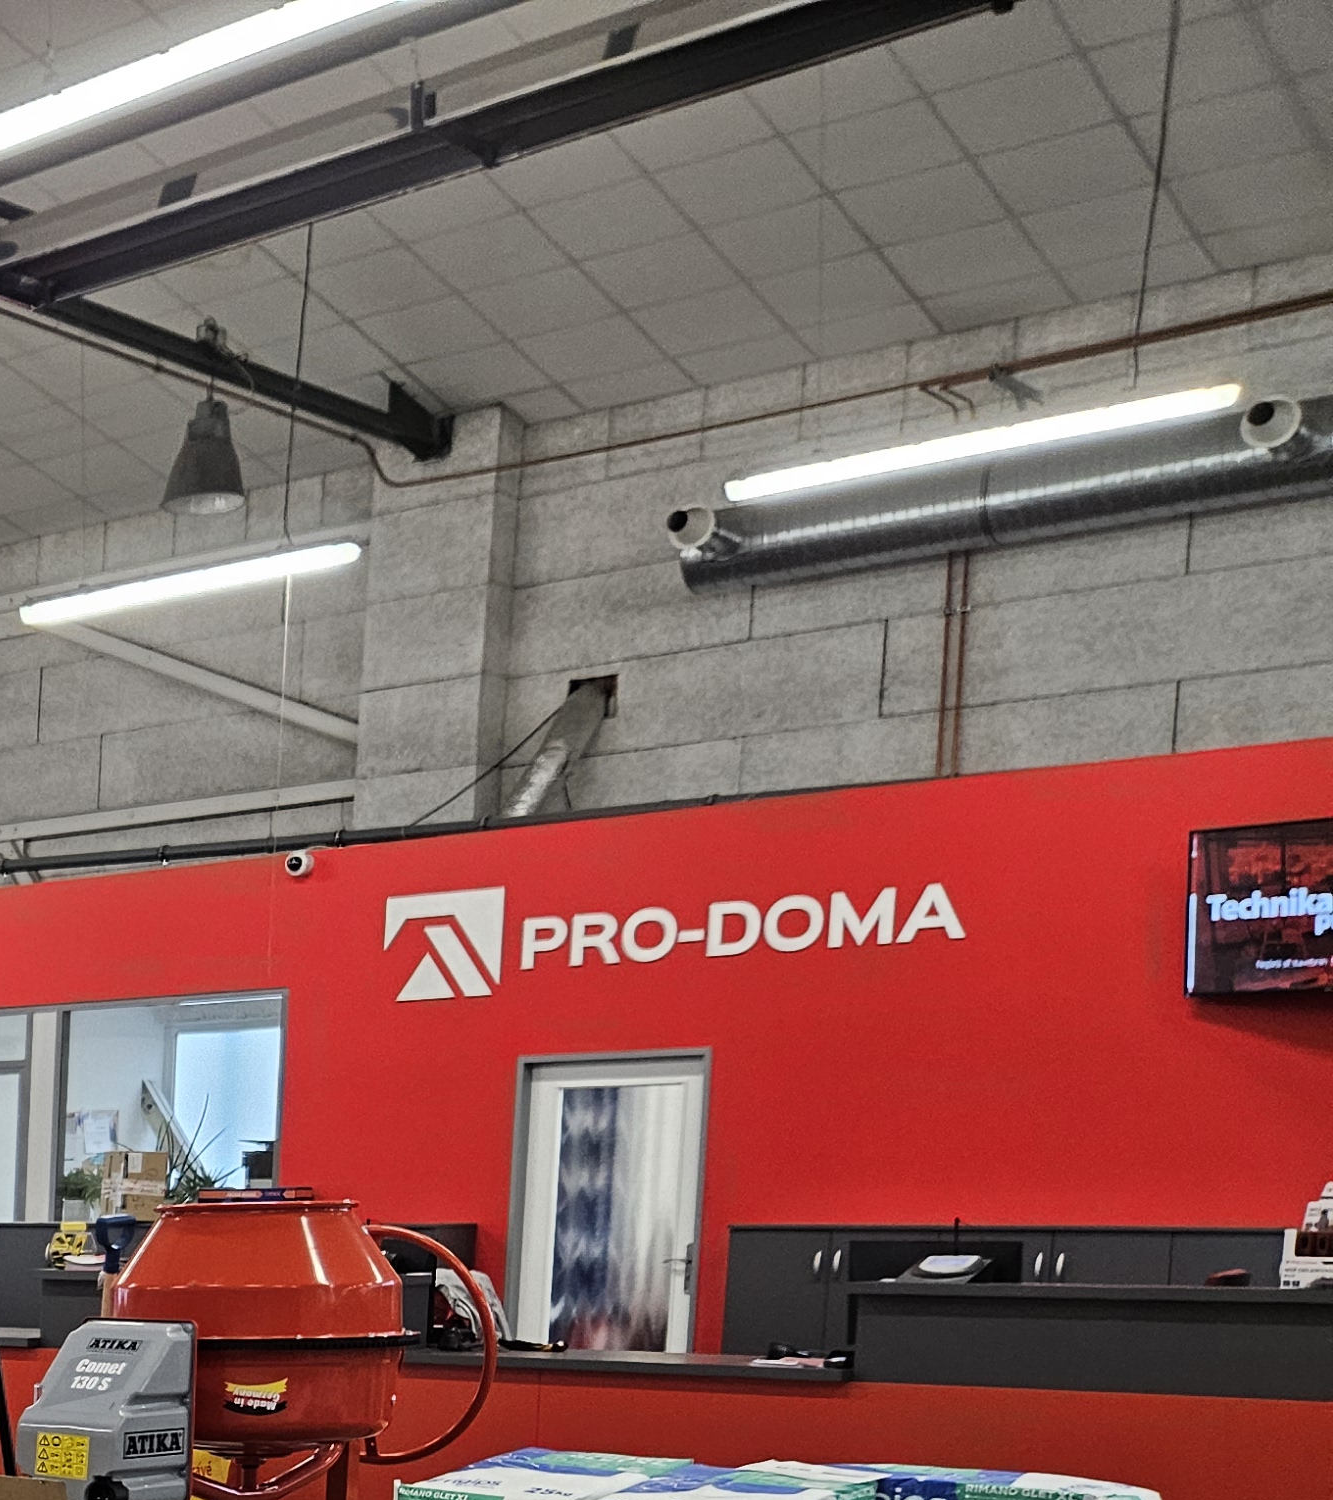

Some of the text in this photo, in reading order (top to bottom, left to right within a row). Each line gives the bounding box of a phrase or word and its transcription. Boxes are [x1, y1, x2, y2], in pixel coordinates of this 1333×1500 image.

[1205, 886, 1333, 922] Technika
[520, 882, 966, 970] PRO-DOMA
[89, 1338, 139, 1352] ATIKA
[75, 1358, 126, 1376] Comet
[70, 1375, 113, 1391] 130 S
[246, 1397, 277, 1411] Made
[125, 1433, 183, 1456] ATIKA
